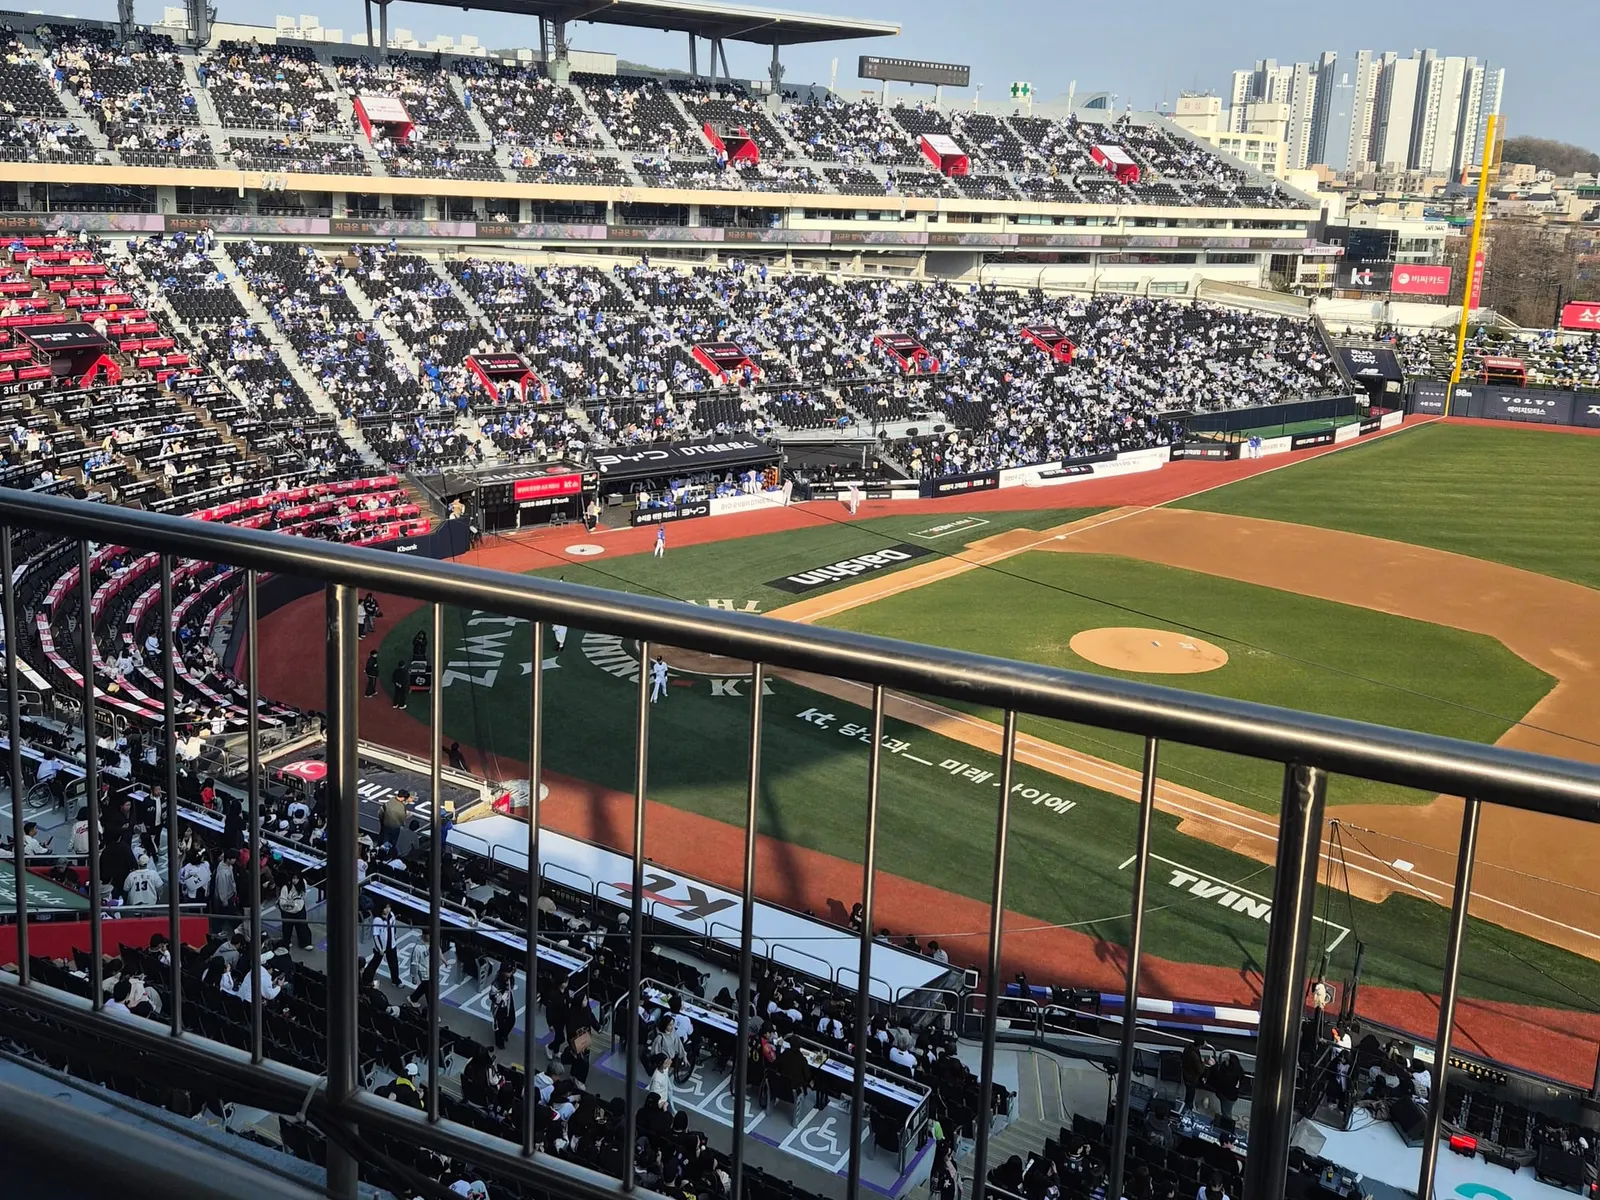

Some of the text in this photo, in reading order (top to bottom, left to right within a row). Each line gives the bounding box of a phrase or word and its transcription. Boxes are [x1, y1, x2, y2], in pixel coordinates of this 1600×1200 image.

[1350, 267, 1374, 286] kt
[1411, 274, 1445, 285] 비씨카드
[3, 385, 19, 394] 316
[1455, 389, 1472, 397] 98m
[1501, 396, 1556, 407] VOLVO
[594, 450, 669, 465] BYD
[681, 506, 707, 516] BYD
[397, 543, 418, 553] Kbank
[786, 548, 912, 585] Daishin
[796, 708, 837, 730] kt,
[938, 758, 994, 783] 미래
[135, 881, 148, 892] 13
[1168, 870, 1272, 924] TVIN
